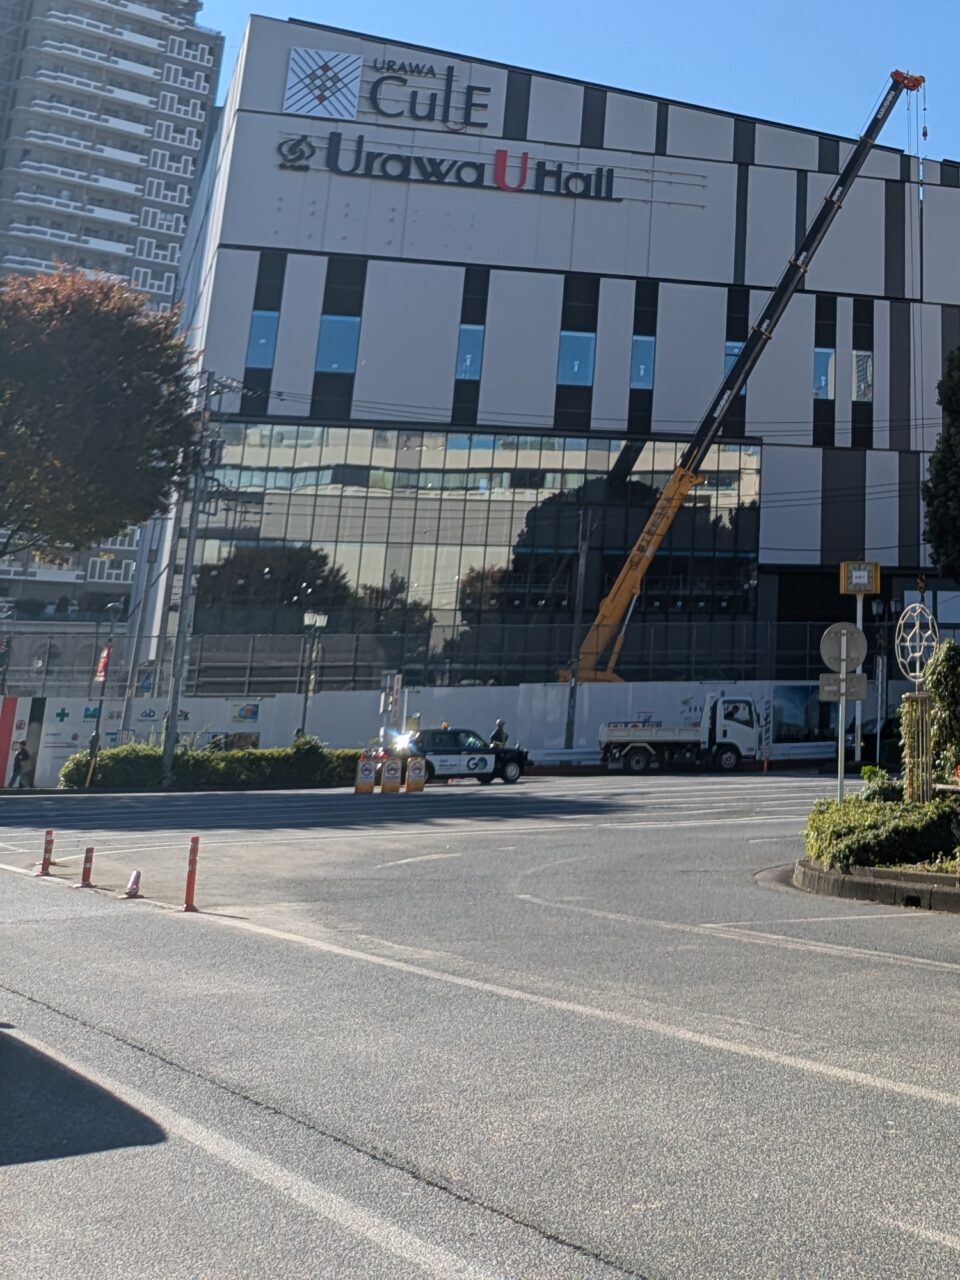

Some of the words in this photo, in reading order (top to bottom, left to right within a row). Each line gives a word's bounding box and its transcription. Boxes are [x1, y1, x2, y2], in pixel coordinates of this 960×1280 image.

[373, 58, 437, 78] URAWA
[325, 131, 486, 185] Urawa
[493, 149, 529, 192] U
[535, 161, 615, 199] Hall
[466, 757, 488, 771] GO
